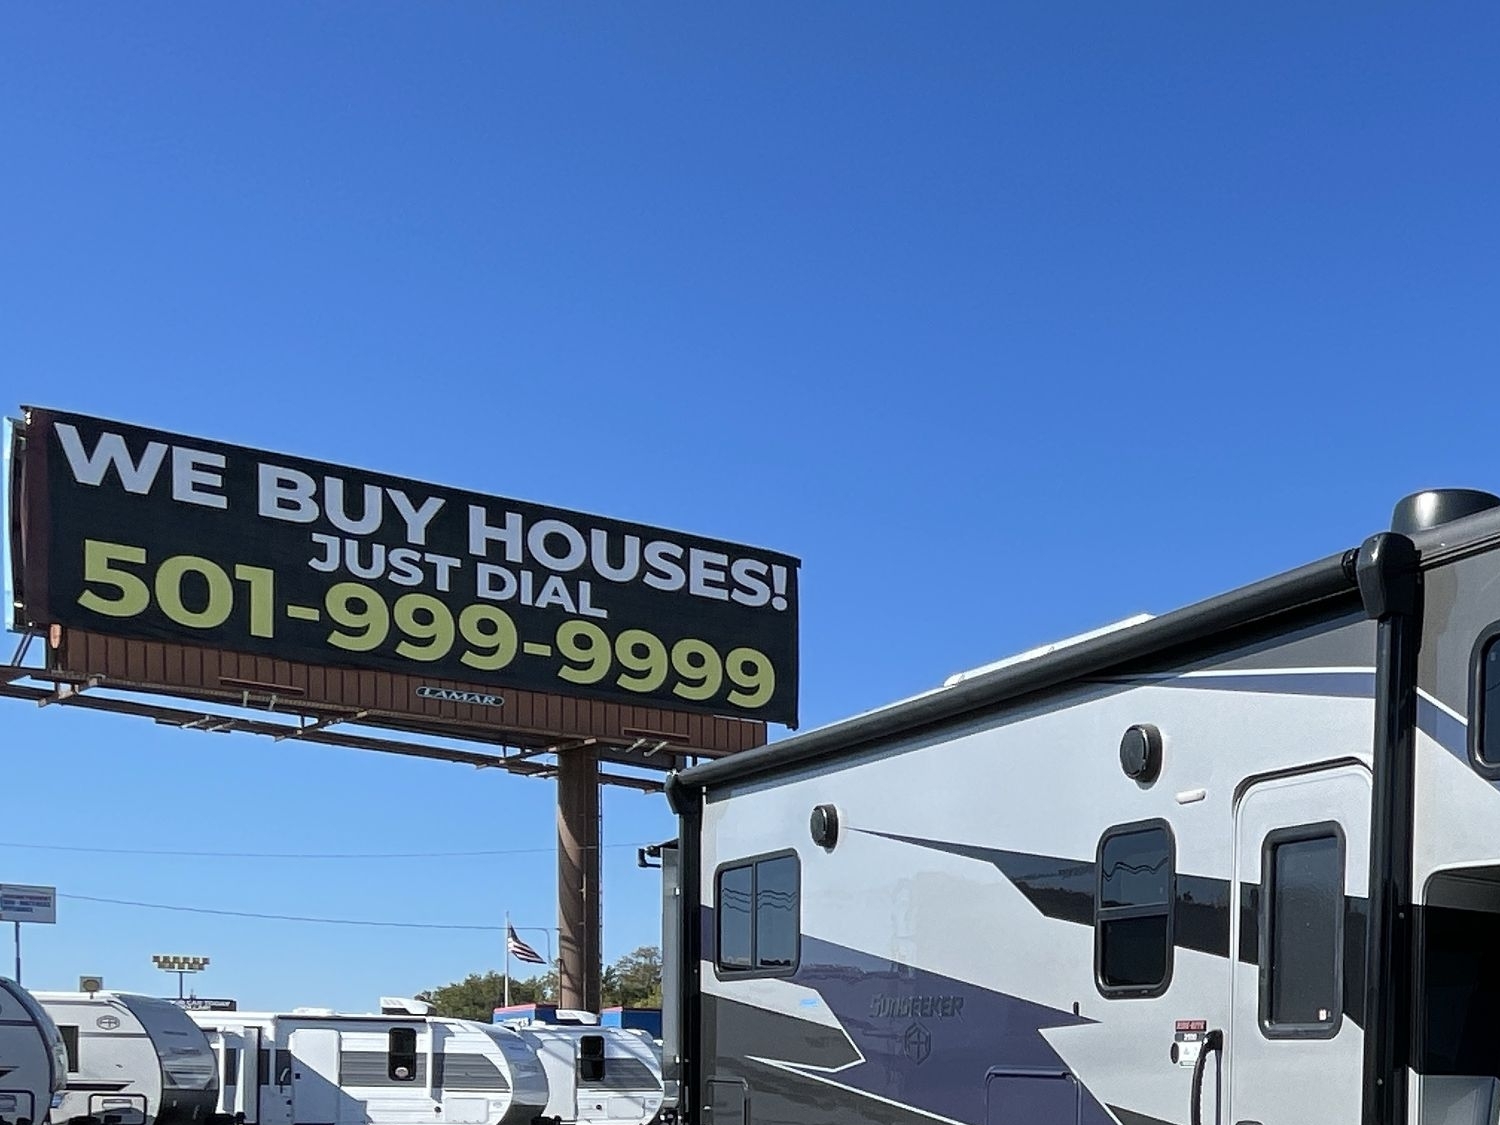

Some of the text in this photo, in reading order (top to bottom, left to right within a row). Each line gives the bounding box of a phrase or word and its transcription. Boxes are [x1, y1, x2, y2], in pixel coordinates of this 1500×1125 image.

[54, 422, 788, 611] WE BUY HOUSES!
[308, 532, 607, 618] JUST DIAL
[77, 539, 775, 708] 501-999-9999
[422, 687, 496, 705] LAMAR
